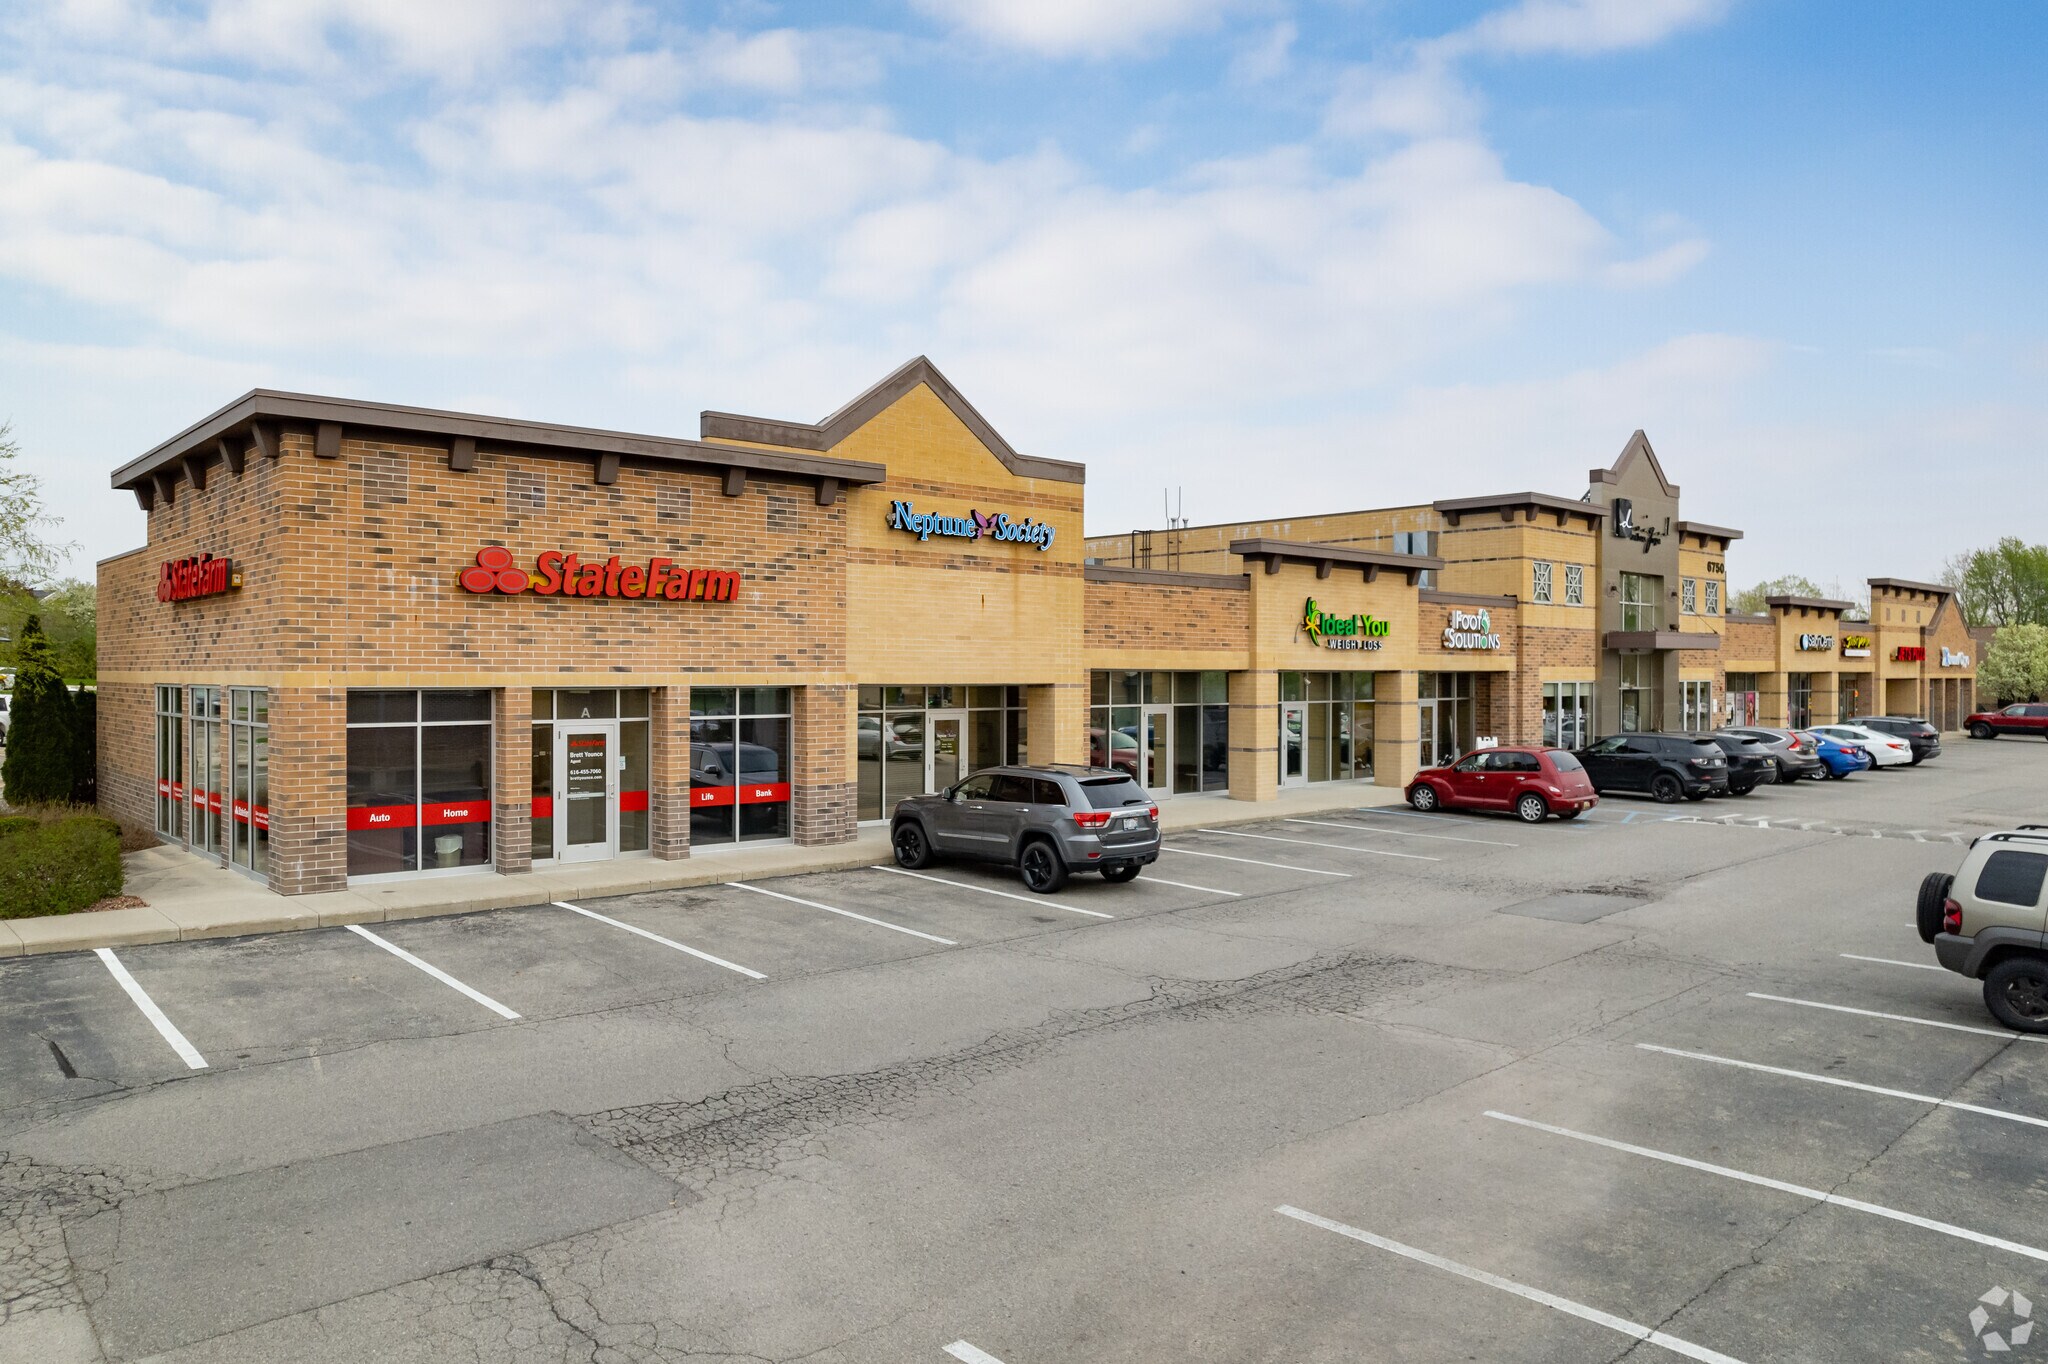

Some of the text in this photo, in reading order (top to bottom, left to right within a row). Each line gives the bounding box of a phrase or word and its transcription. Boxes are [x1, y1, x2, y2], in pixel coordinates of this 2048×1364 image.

[894, 500, 1056, 551] Neptune Society
[1706, 560, 1725, 575] 6750
[1321, 612, 1391, 637] Ideal You
[1453, 609, 1482, 631] FOOT
[1328, 638, 1384, 651] WEIGHT LOSS
[1446, 627, 1501, 650] SOLUTIONS
[580, 707, 591, 718] A
[701, 793, 714, 801] Life
[755, 789, 773, 798] Bank
[369, 813, 391, 823] Auto
[443, 808, 469, 818] Home
